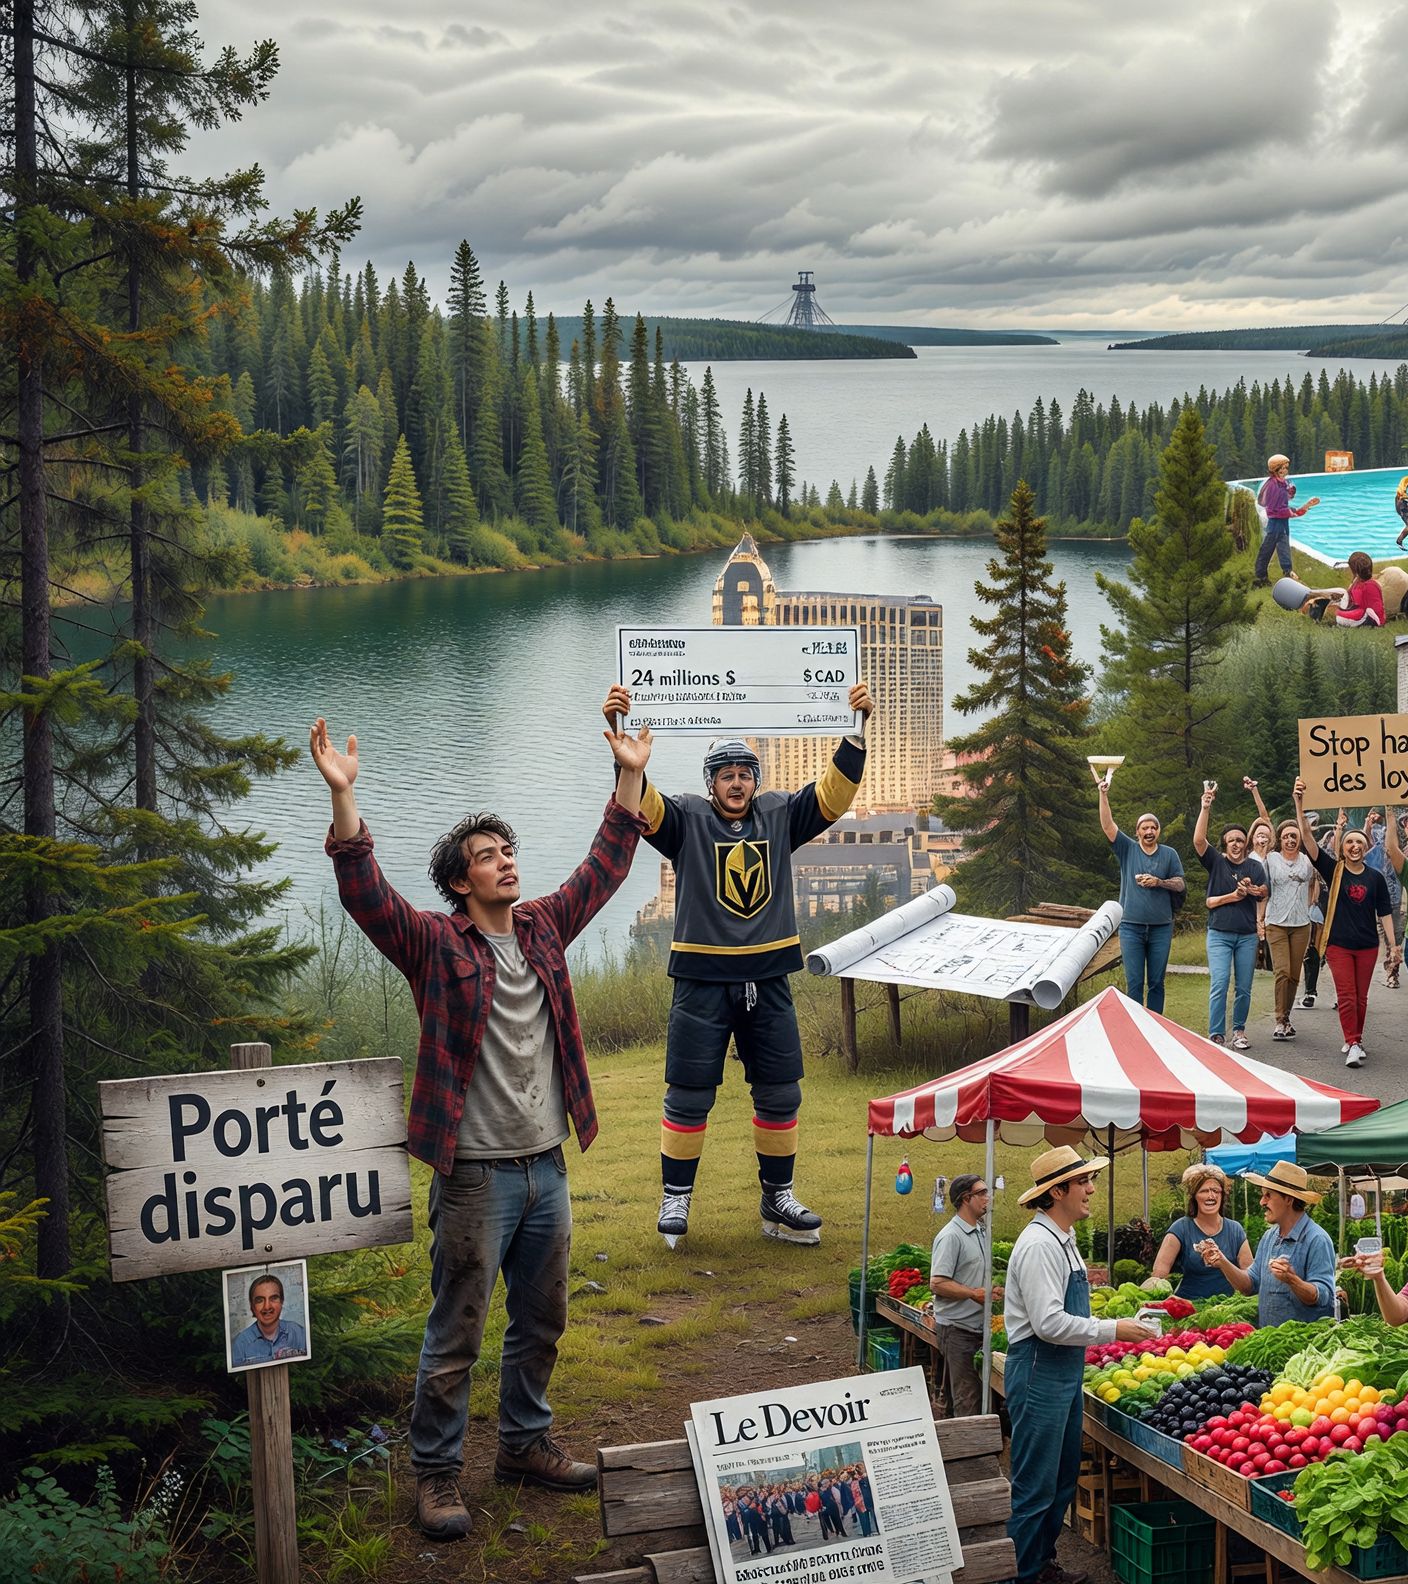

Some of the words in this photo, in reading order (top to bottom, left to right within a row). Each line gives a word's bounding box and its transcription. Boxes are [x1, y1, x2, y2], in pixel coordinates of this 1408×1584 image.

[632, 669, 654, 686] 24
[660, 669, 720, 686] millions
[725, 669, 736, 686] $
[1309, 725, 1370, 766] Stop
[1324, 762, 1367, 792] des
[168, 1080, 344, 1162] Porté
[140, 1170, 382, 1250] disparu
[710, 1411, 758, 1446] Le
[758, 1392, 870, 1439] Devoir
